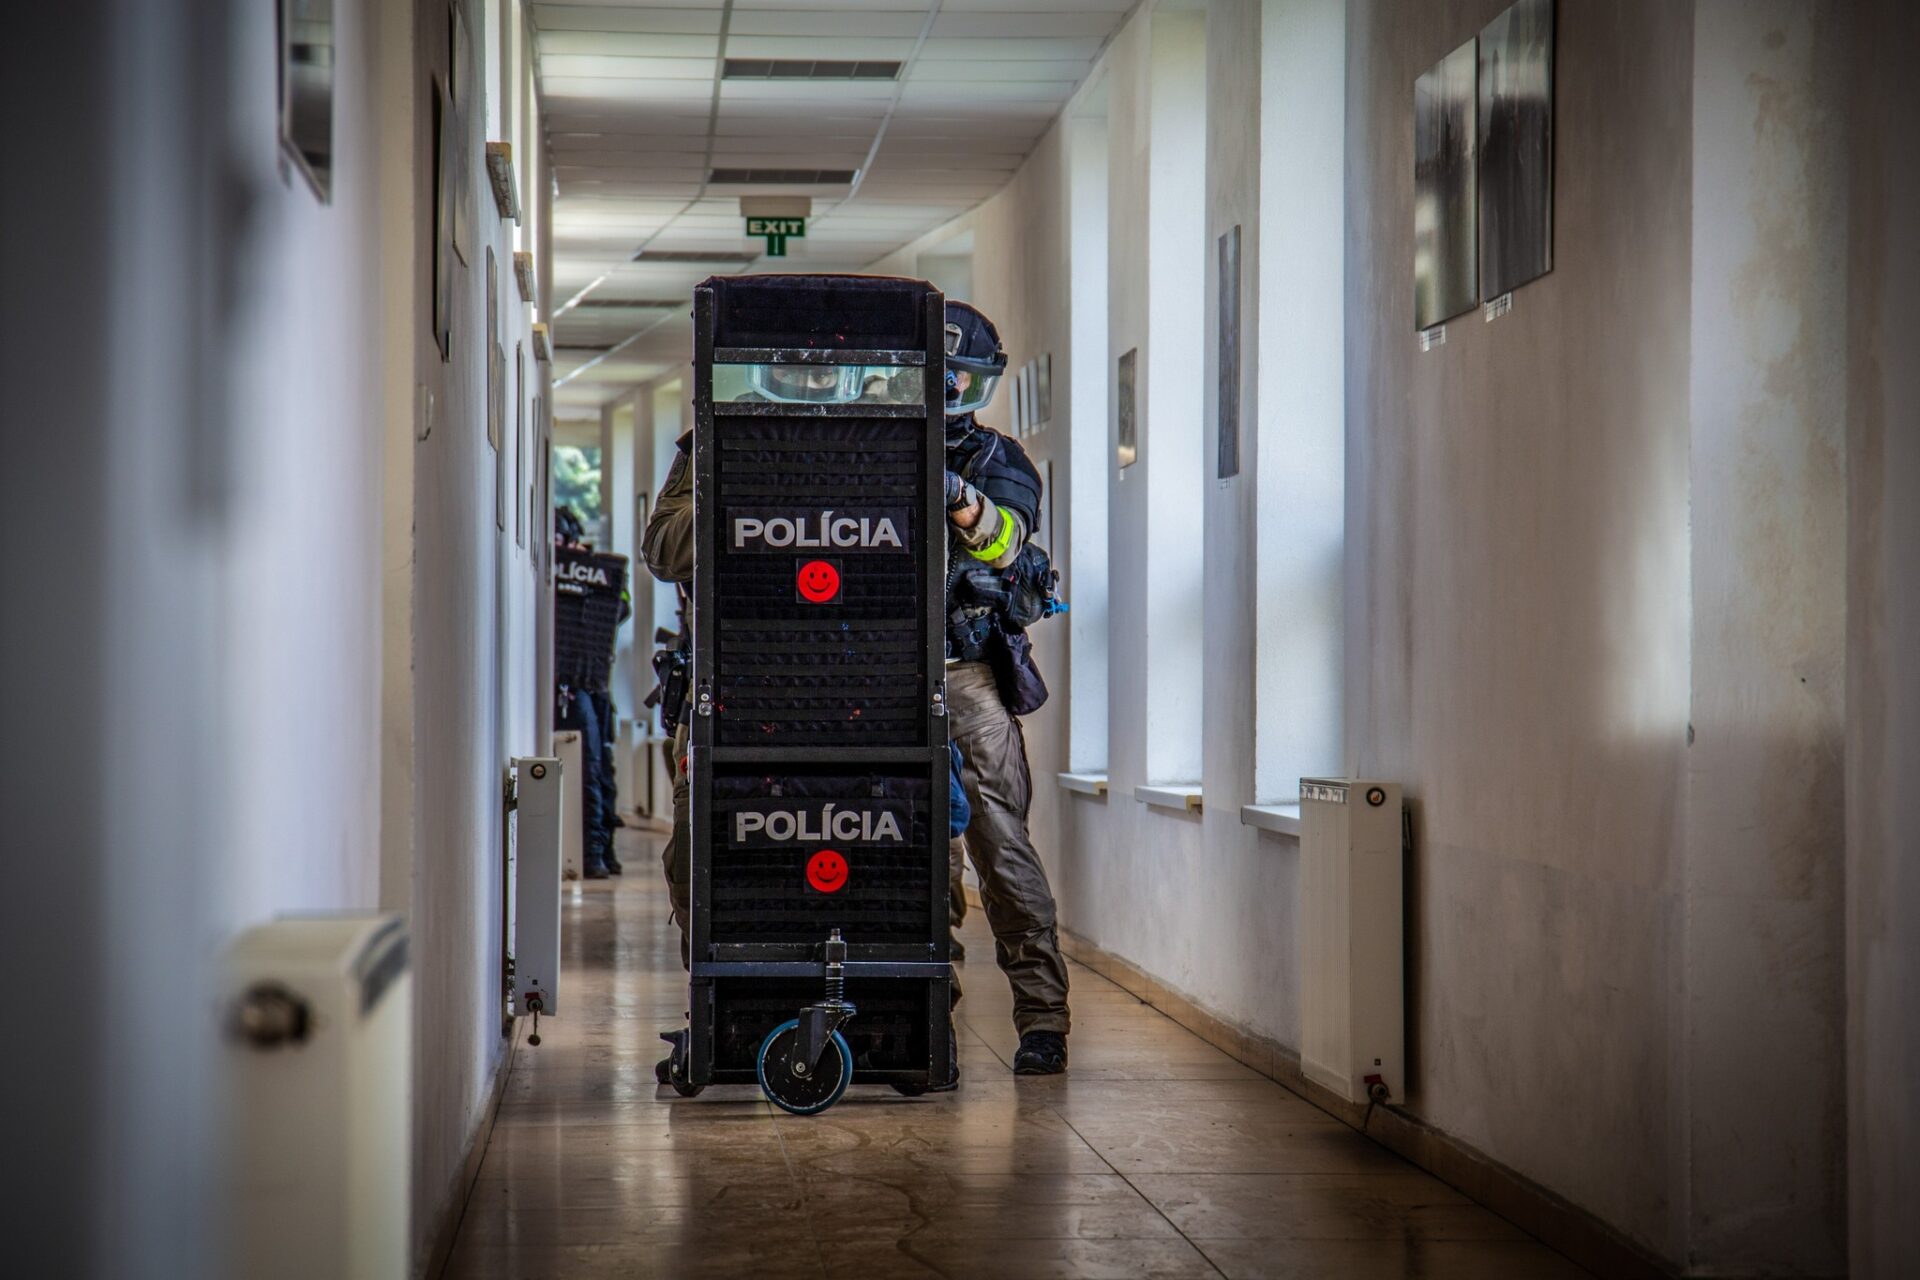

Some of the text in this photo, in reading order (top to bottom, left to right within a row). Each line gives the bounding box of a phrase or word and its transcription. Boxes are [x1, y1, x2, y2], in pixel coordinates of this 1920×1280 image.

[749, 220, 802, 234] EXIT
[734, 510, 903, 548] POLÍCIA
[555, 561, 608, 585] LÍCIA
[735, 803, 904, 842] POLÍCIA
